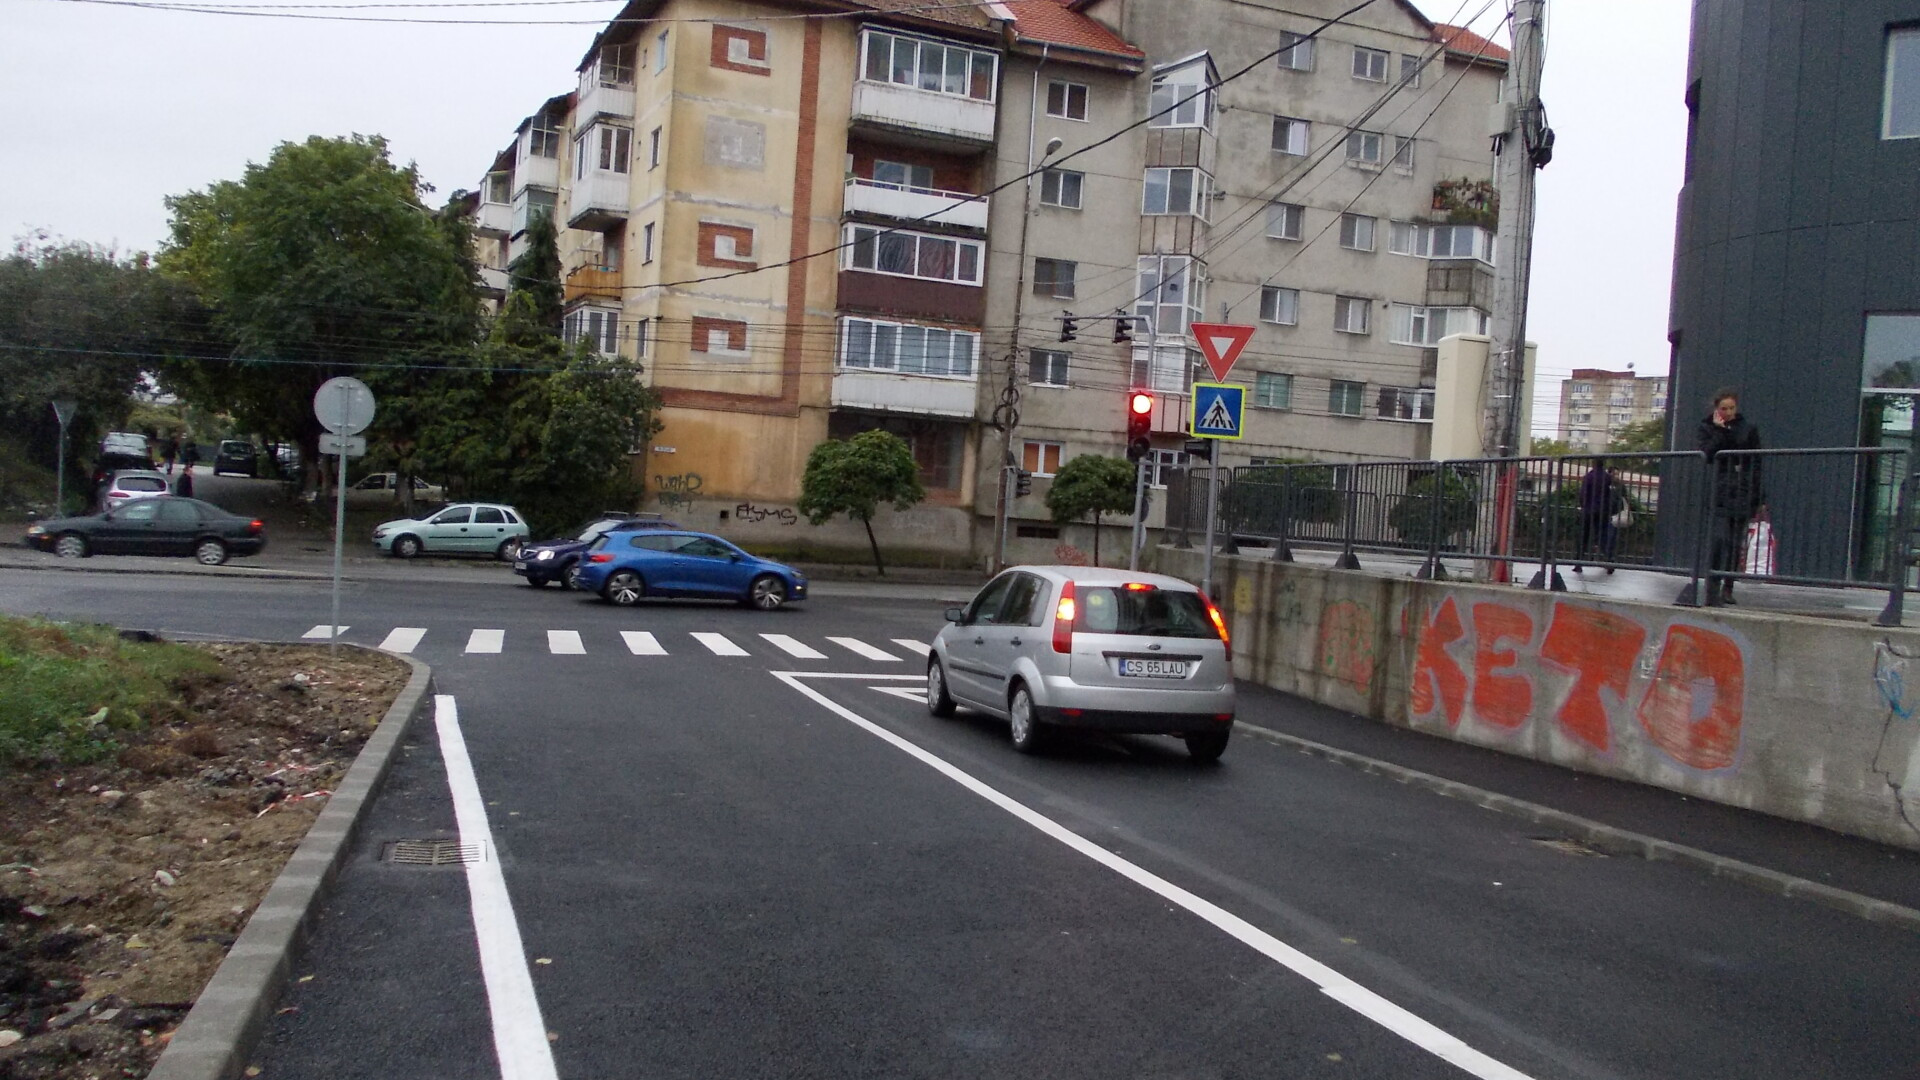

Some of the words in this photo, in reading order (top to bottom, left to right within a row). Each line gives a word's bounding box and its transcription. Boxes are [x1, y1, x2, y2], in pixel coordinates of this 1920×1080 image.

[1127, 660, 1143, 673] CS
[1147, 661, 1160, 673] 65
[1161, 662, 1183, 674] LAU
[1402, 594, 1746, 771] KETO
